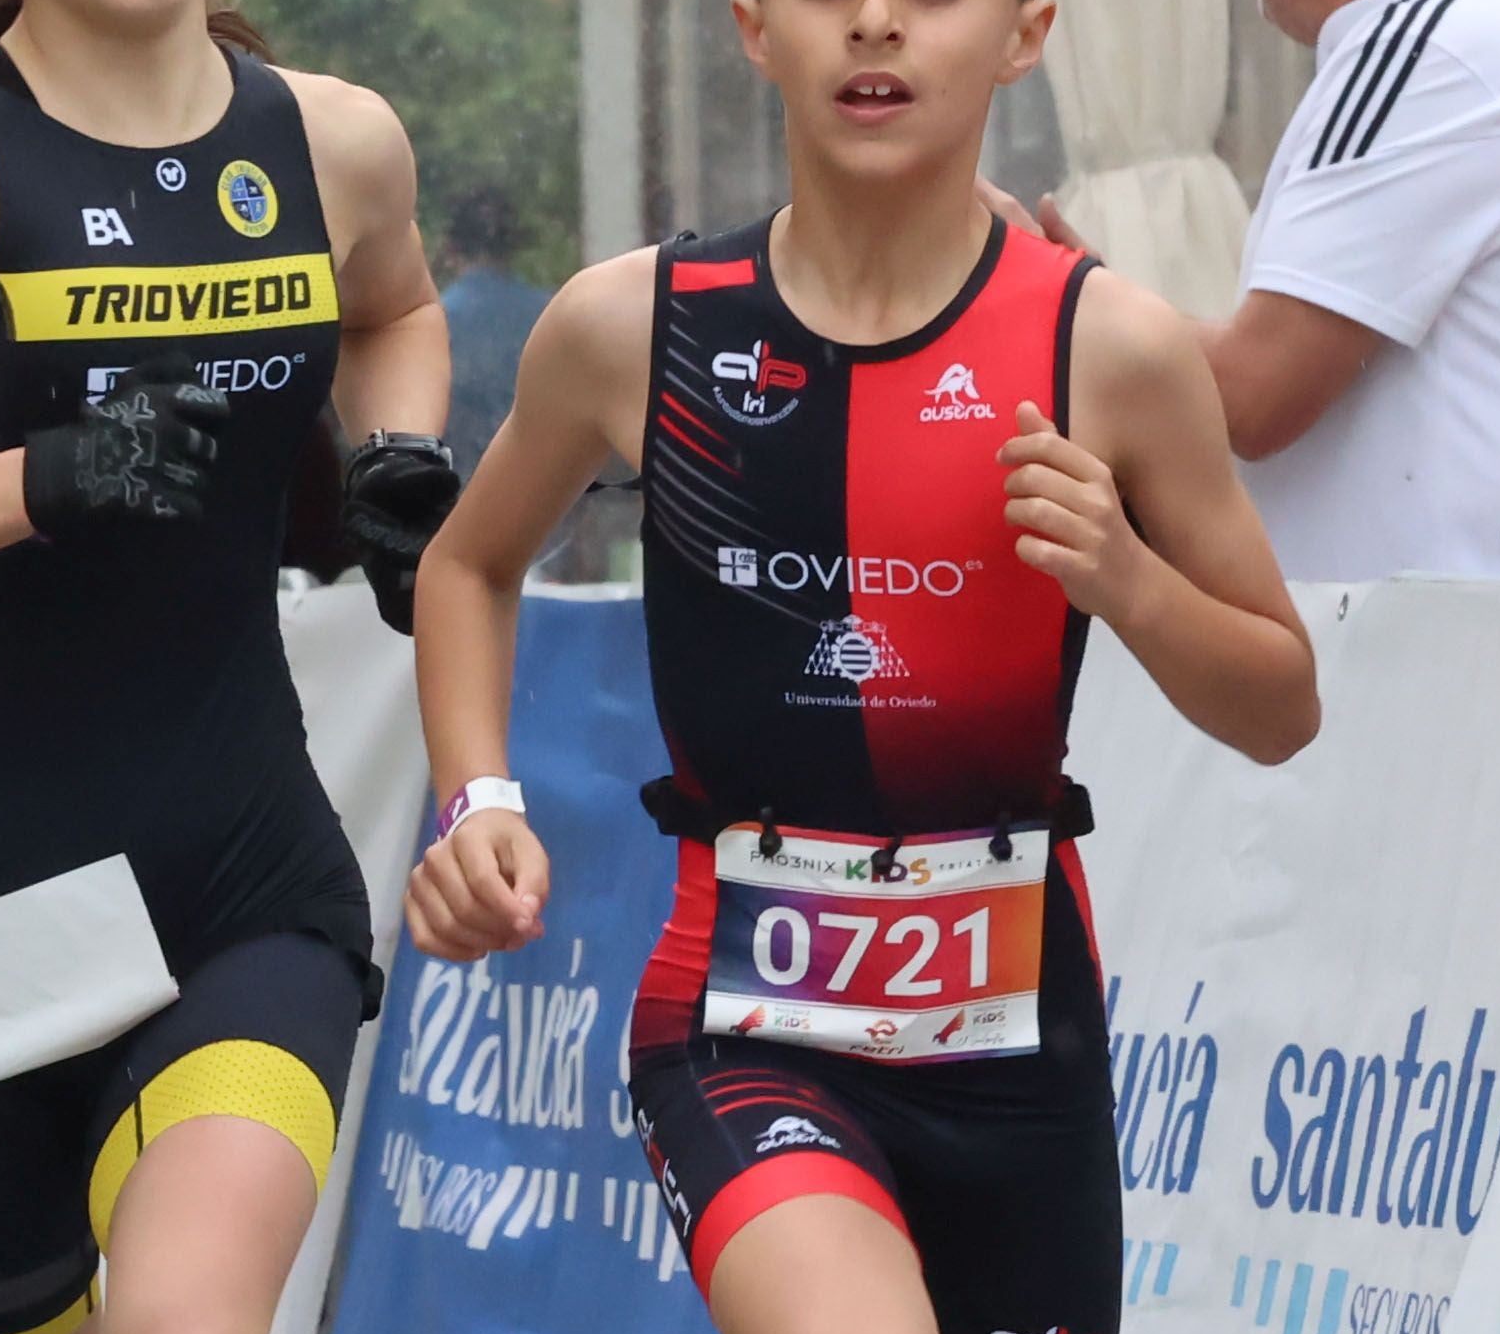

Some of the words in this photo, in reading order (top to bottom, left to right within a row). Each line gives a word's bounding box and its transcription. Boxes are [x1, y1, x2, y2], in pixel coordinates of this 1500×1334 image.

[66, 271, 312, 326] TRIOVIEDO
[784, 691, 867, 708] Universidad
[869, 692, 887, 708] de
[888, 694, 937, 709] Oviedo
[752, 905, 990, 997] 0721
